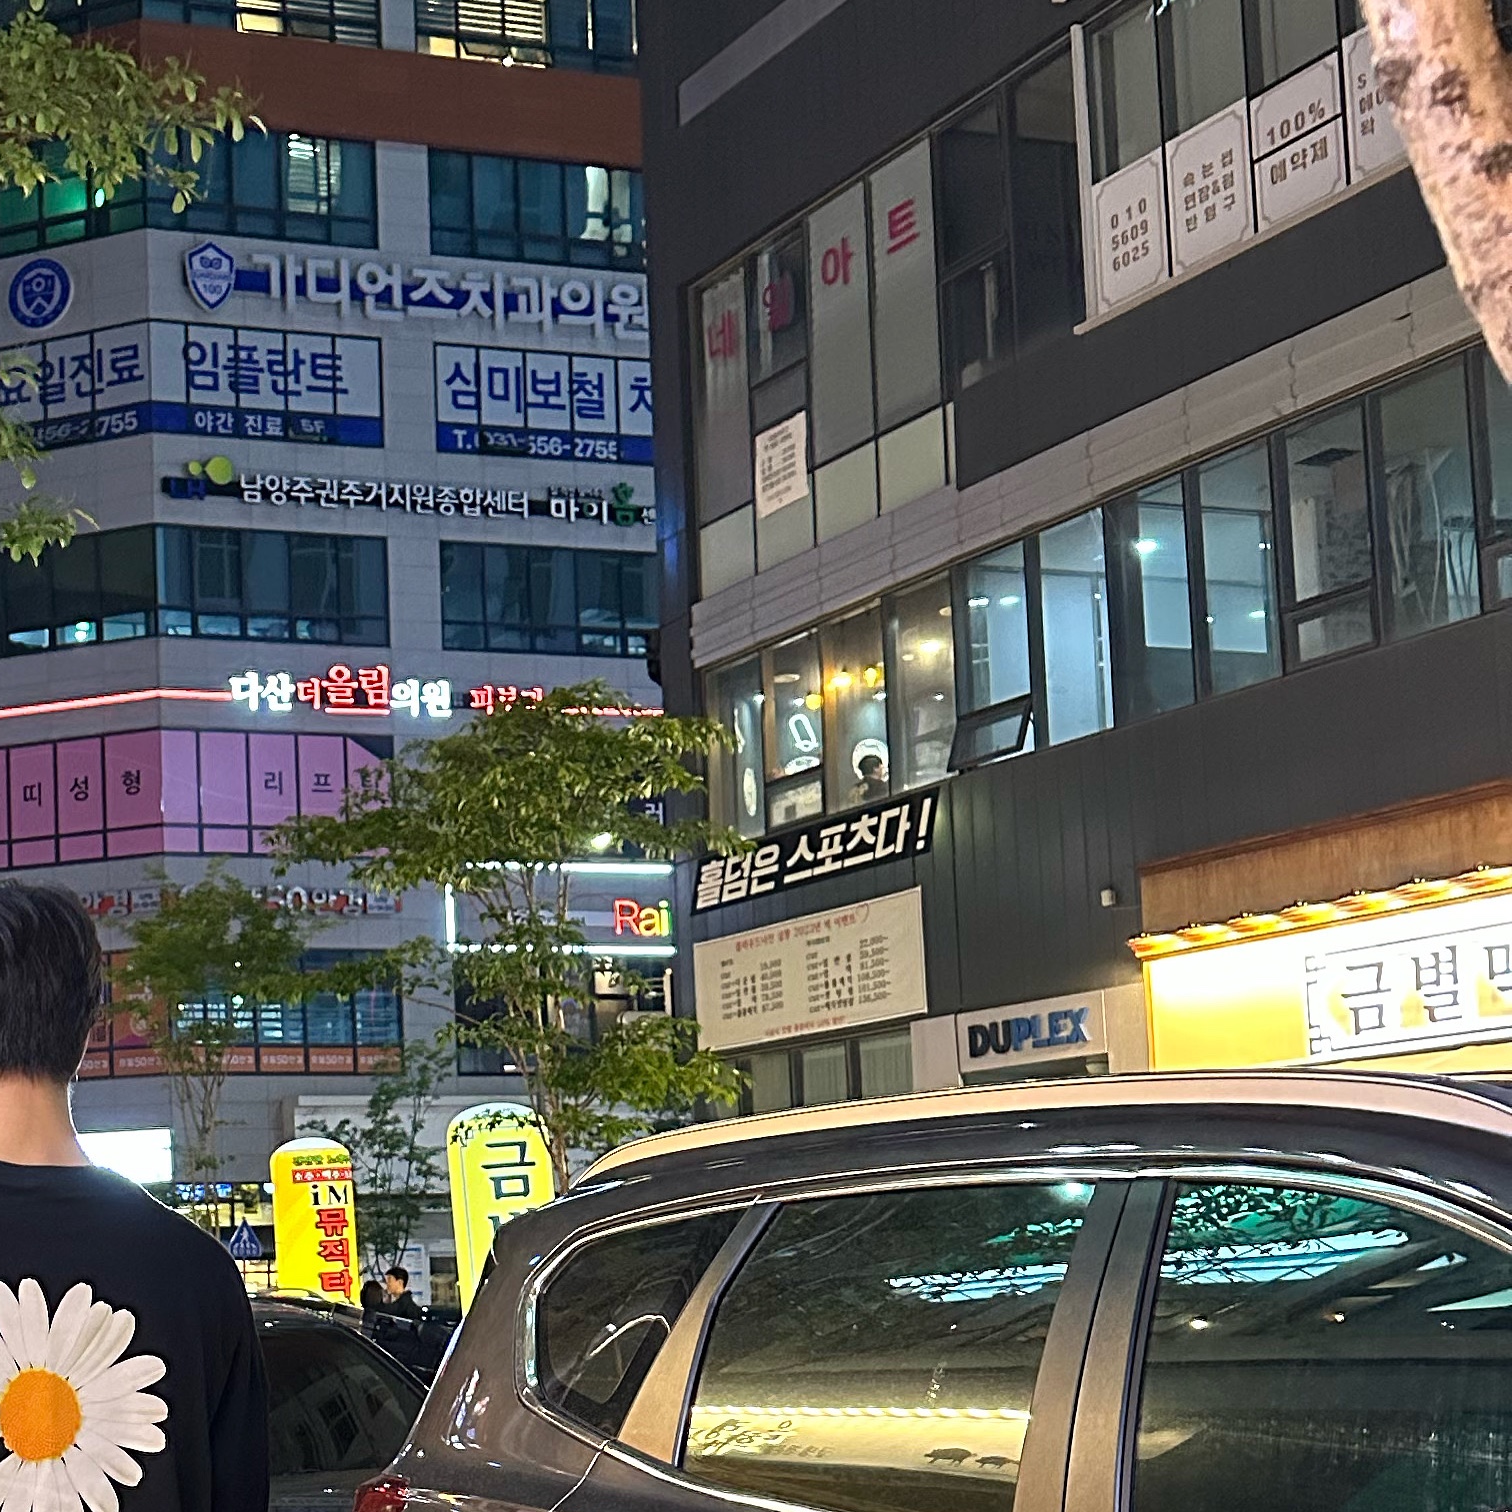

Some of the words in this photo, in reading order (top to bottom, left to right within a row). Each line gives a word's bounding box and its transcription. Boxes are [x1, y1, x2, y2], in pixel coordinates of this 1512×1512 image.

[1267, 98, 1325, 145] 100%
[1270, 135, 1327, 185] 예약제
[1111, 198, 1146, 230] 010
[1112, 219, 1149, 252] 5609
[1113, 240, 1149, 272] 6025
[183, 340, 349, 396] 임플란트
[444, 361, 606, 420] 심미보철
[194, 411, 235, 434] 야간
[244, 415, 285, 437] 진료
[696, 844, 780, 910] 홀덤은
[967, 1007, 1091, 1058] DUPLEX
